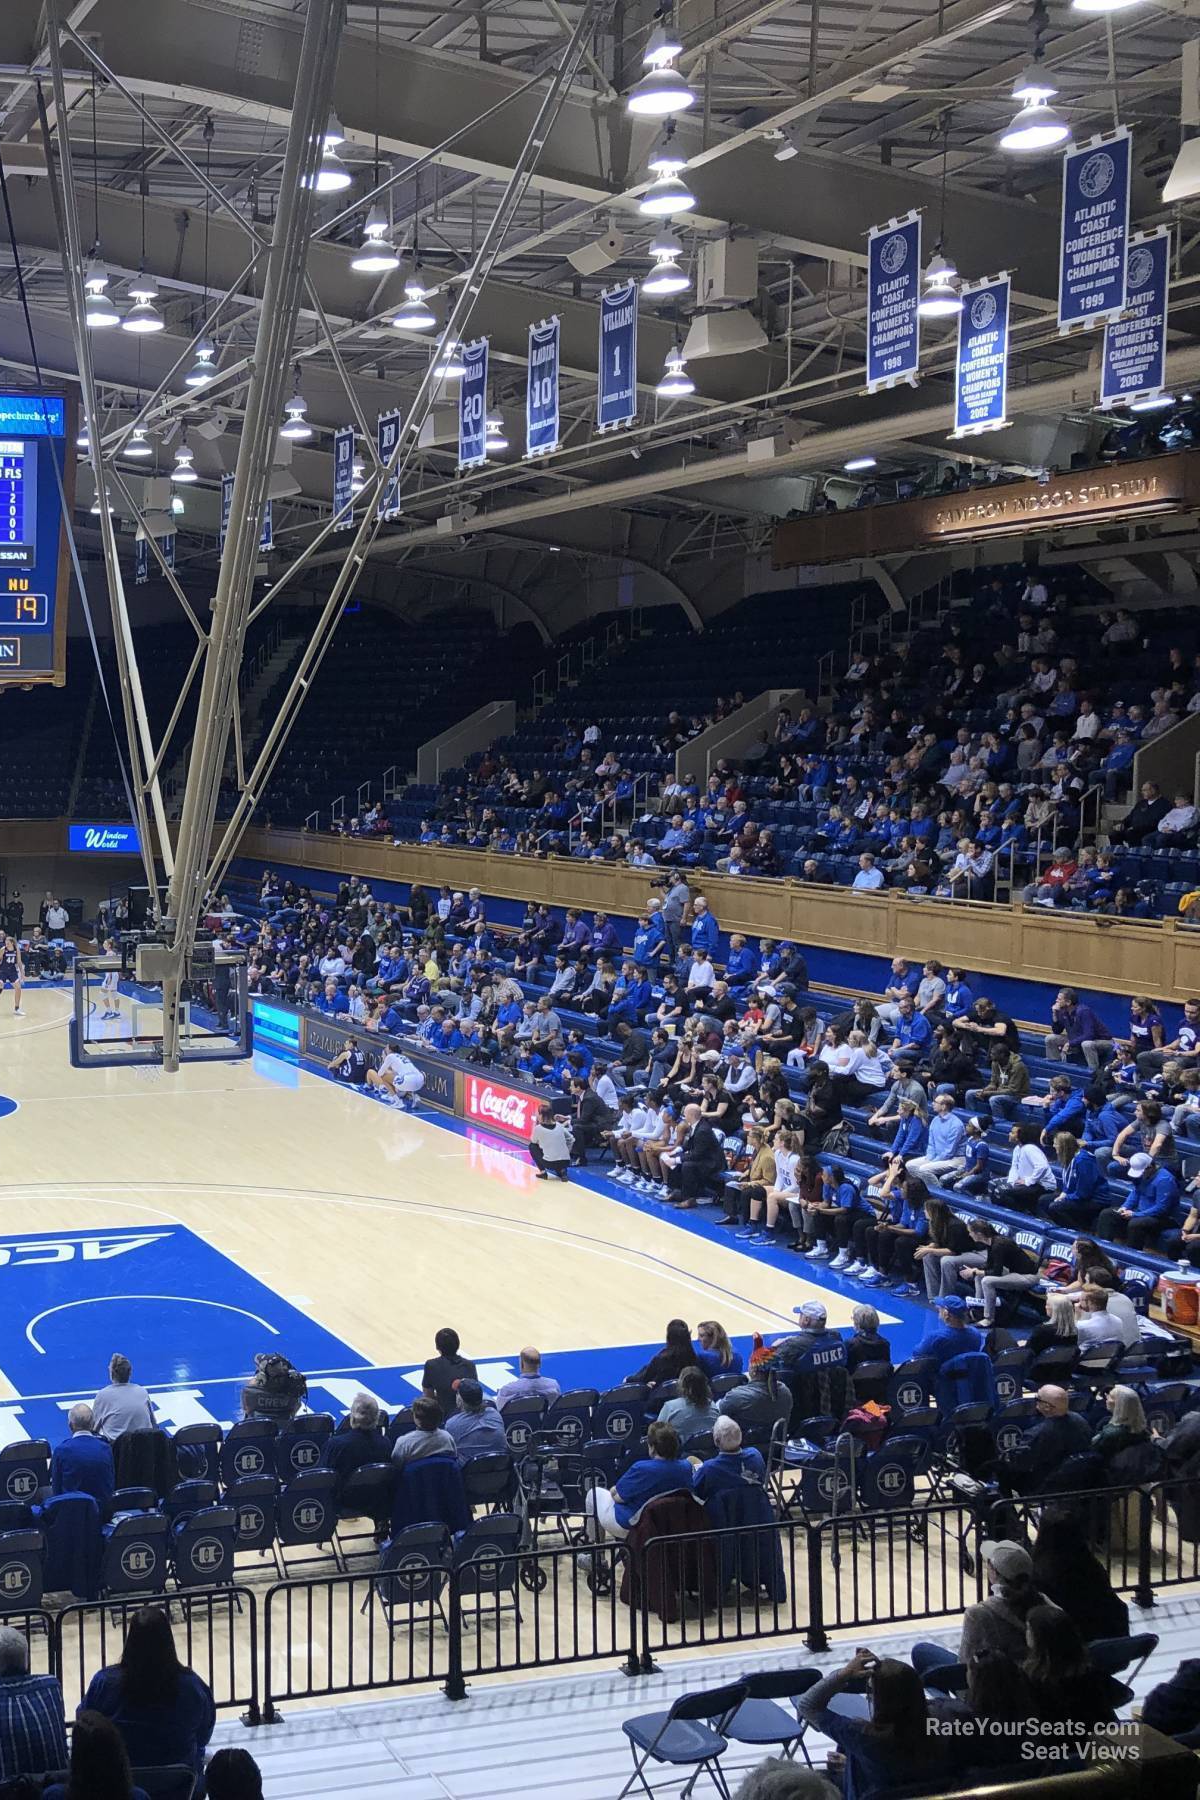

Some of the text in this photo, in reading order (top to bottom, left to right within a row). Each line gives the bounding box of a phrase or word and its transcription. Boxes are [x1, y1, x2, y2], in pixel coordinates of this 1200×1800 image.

[1075, 200, 1117, 222] ATLANTIC
[1080, 216, 1110, 235] COAST
[1066, 226, 1123, 253] CONFERENCE
[1073, 243, 1115, 265] WOMEN'S
[1067, 256, 1119, 281] CHAMPIONS
[877, 275, 909, 295] ATLANTIC
[882, 289, 904, 306] COAST
[1080, 293, 1104, 310] 1999
[1125, 290, 1155, 306] TLANTIC
[872, 297, 916, 322] CONFERENCE
[877, 313, 909, 332] WOMEN'S
[1109, 315, 1162, 336] CONFERENCE
[873, 324, 913, 346] CHAMPIONS
[968, 331, 999, 348] ATLANTIC
[1115, 329, 1153, 348] WOMEN'S
[972, 344, 993, 358] COAST
[1109, 341, 1159, 362] CHAMPIONS
[614, 346, 620, 376] 1
[883, 356, 902, 370] 1998
[961, 353, 1003, 373] CONFERENCE
[966, 366, 998, 382] WOMEN'S
[1120, 374, 1143, 389] 2003
[533, 377, 551, 408] 10
[962, 379, 1000, 395] CHAMPIONS
[464, 394, 482, 422] 20
[970, 406, 988, 419] 2002
[5, 469, 22, 478] FLS
[10, 493, 16, 503] 2
[936, 477, 1158, 525] CAMERON INDOOR STADIUM
[10, 505, 16, 516] 0
[10, 518, 16, 528] 0
[9, 530, 16, 540] 0
[8, 578, 29, 591] NU
[16, 597, 37, 620] 19
[1015, 1232, 1042, 1250] DUKE
[813, 1347, 843, 1366] DUKE
